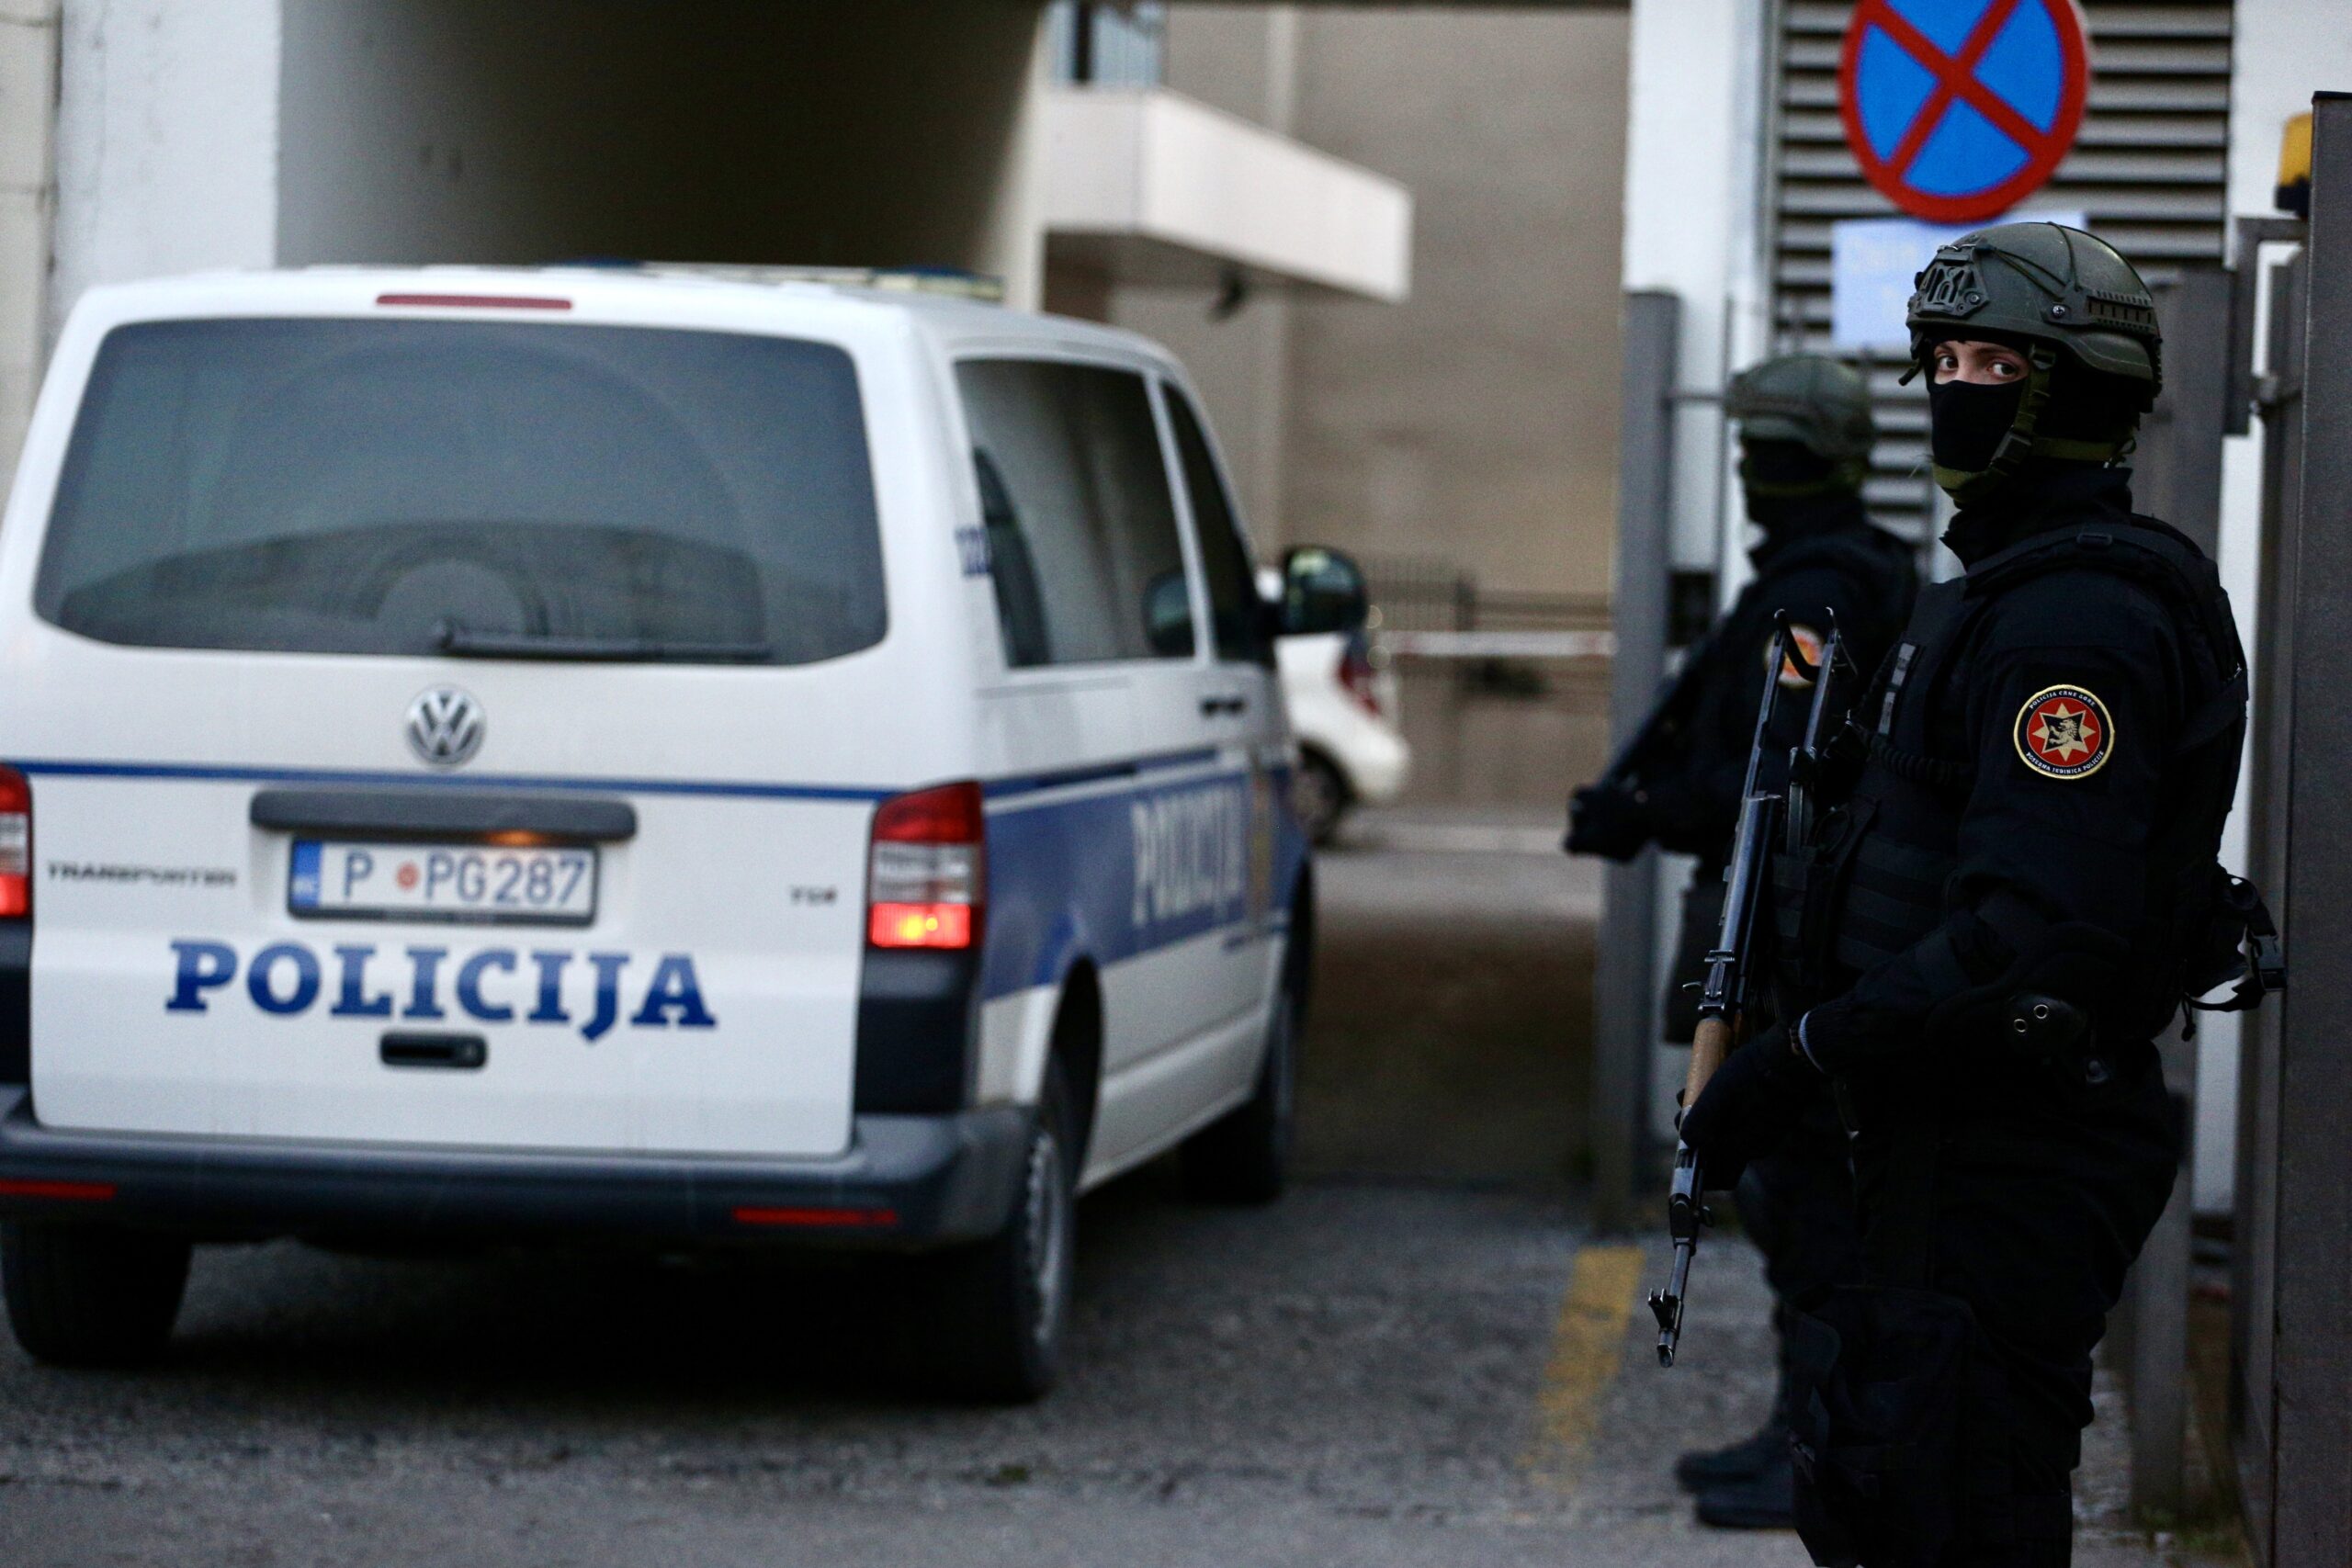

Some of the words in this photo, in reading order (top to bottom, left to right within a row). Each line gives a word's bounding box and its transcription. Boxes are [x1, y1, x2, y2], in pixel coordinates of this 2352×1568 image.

[2029, 692, 2057, 709] POLICIJA
[2078, 694, 2096, 706] GORE
[2026, 751, 2051, 772] POSEBNA
[2083, 750, 2104, 771] POLICIJE
[343, 850, 374, 898] P
[424, 849, 587, 908] PG287
[165, 940, 718, 1042] POLICIJA
